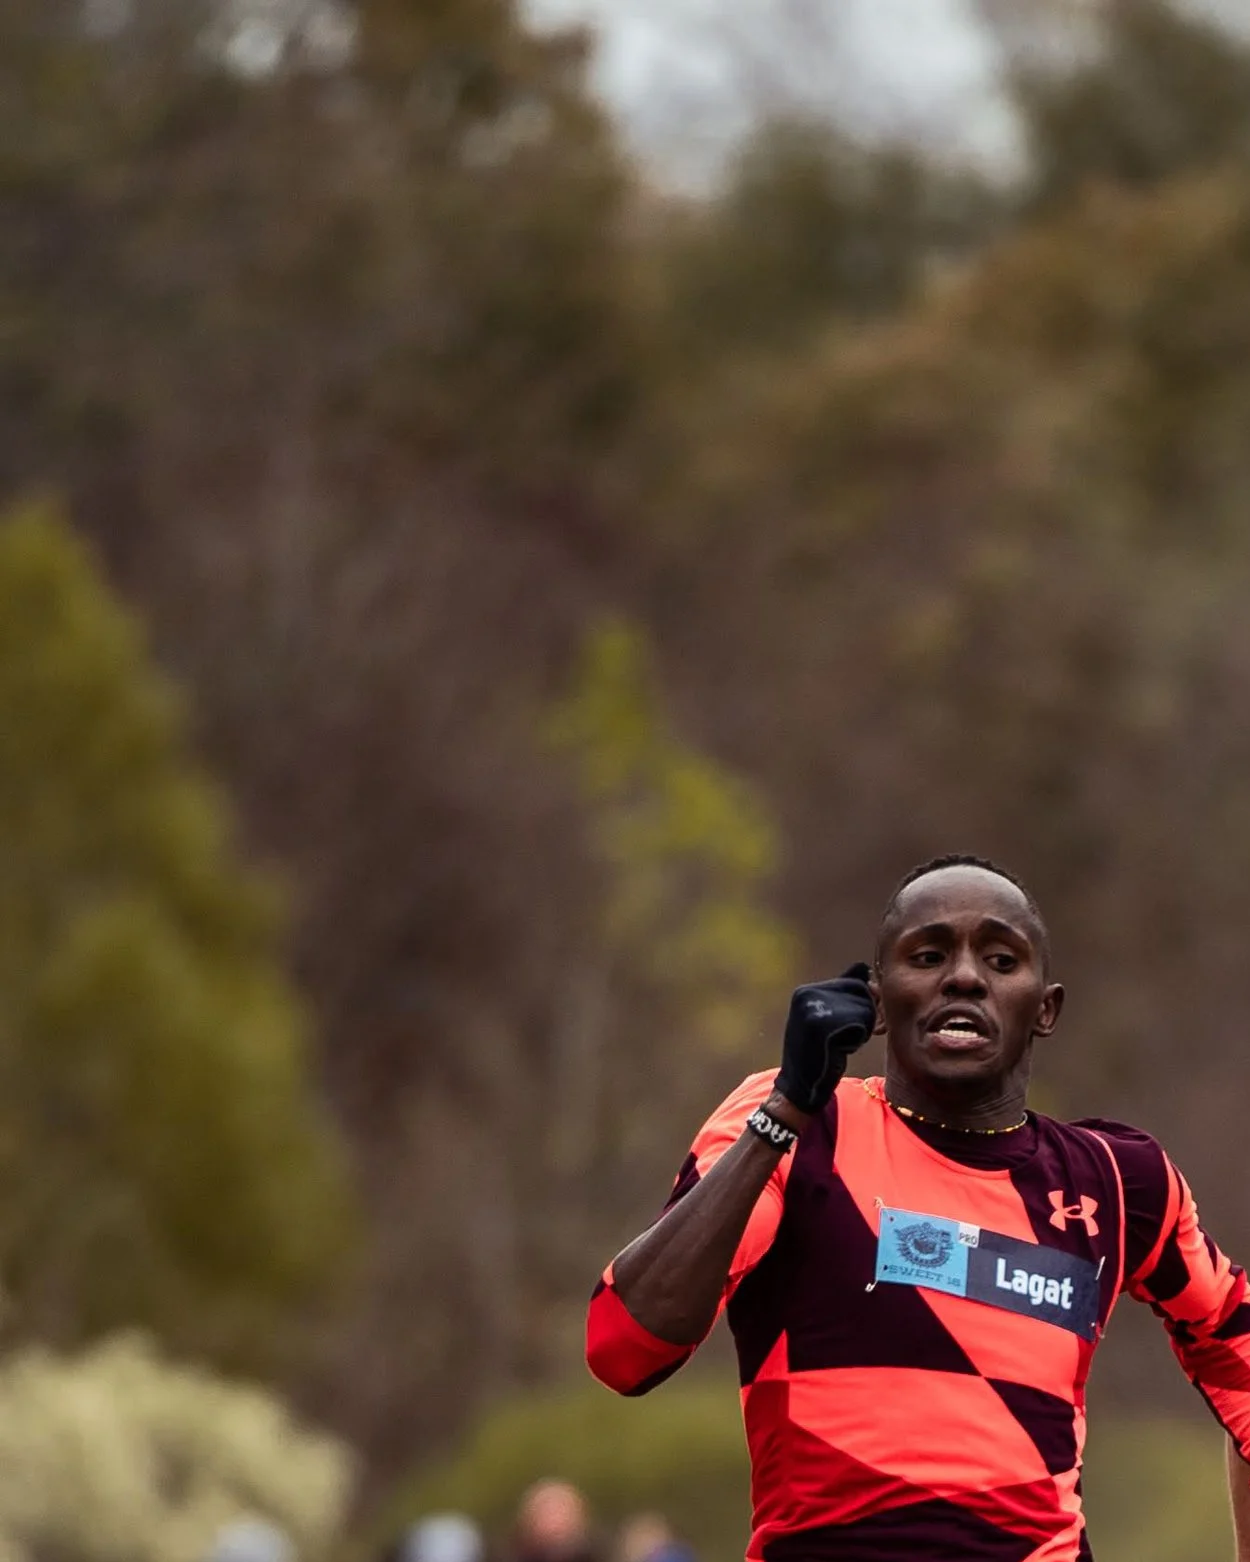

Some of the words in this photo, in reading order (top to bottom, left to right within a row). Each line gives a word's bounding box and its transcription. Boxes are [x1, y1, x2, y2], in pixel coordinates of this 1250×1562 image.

[959, 1232, 978, 1245] PRO
[888, 1264, 944, 1282] SWEET
[996, 1257, 1074, 1310] Lagat
